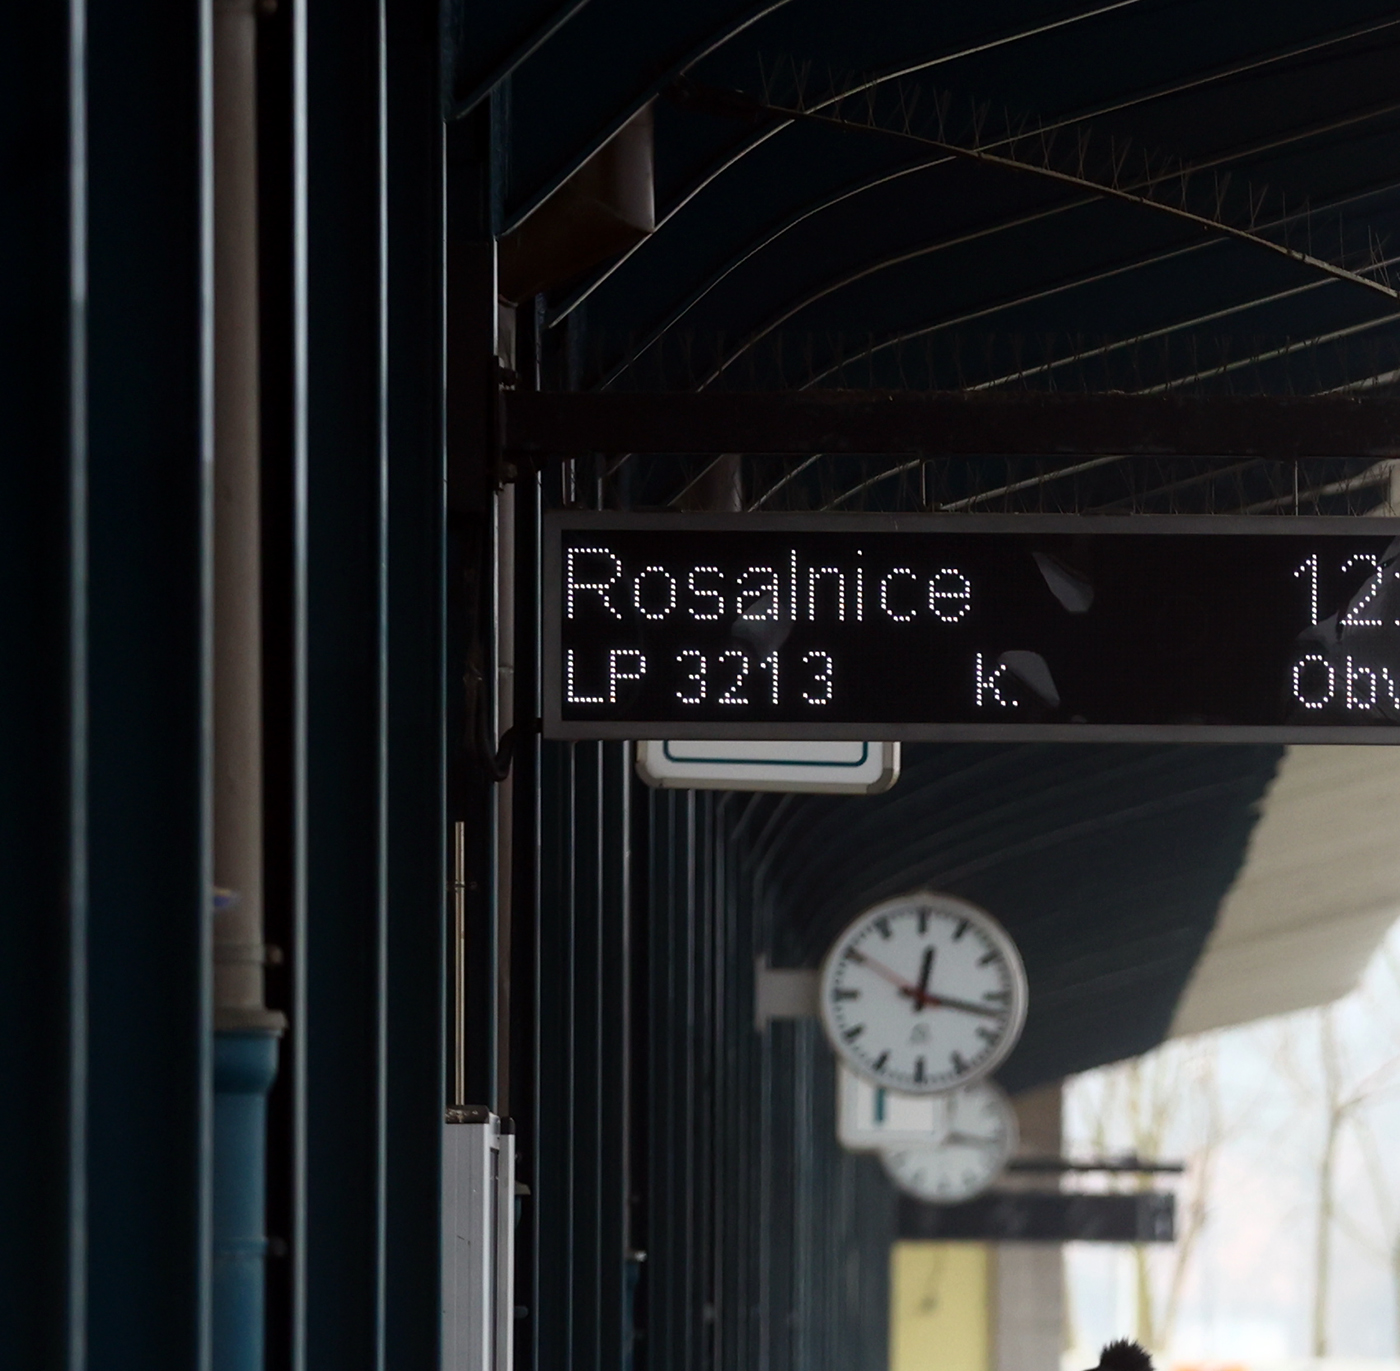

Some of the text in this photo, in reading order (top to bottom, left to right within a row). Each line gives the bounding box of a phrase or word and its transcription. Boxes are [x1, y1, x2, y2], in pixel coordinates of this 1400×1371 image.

[566, 546, 973, 624] Rosalnice
[566, 648, 648, 704] LP
[675, 649, 834, 706] 3213
[975, 651, 1019, 708] k.
